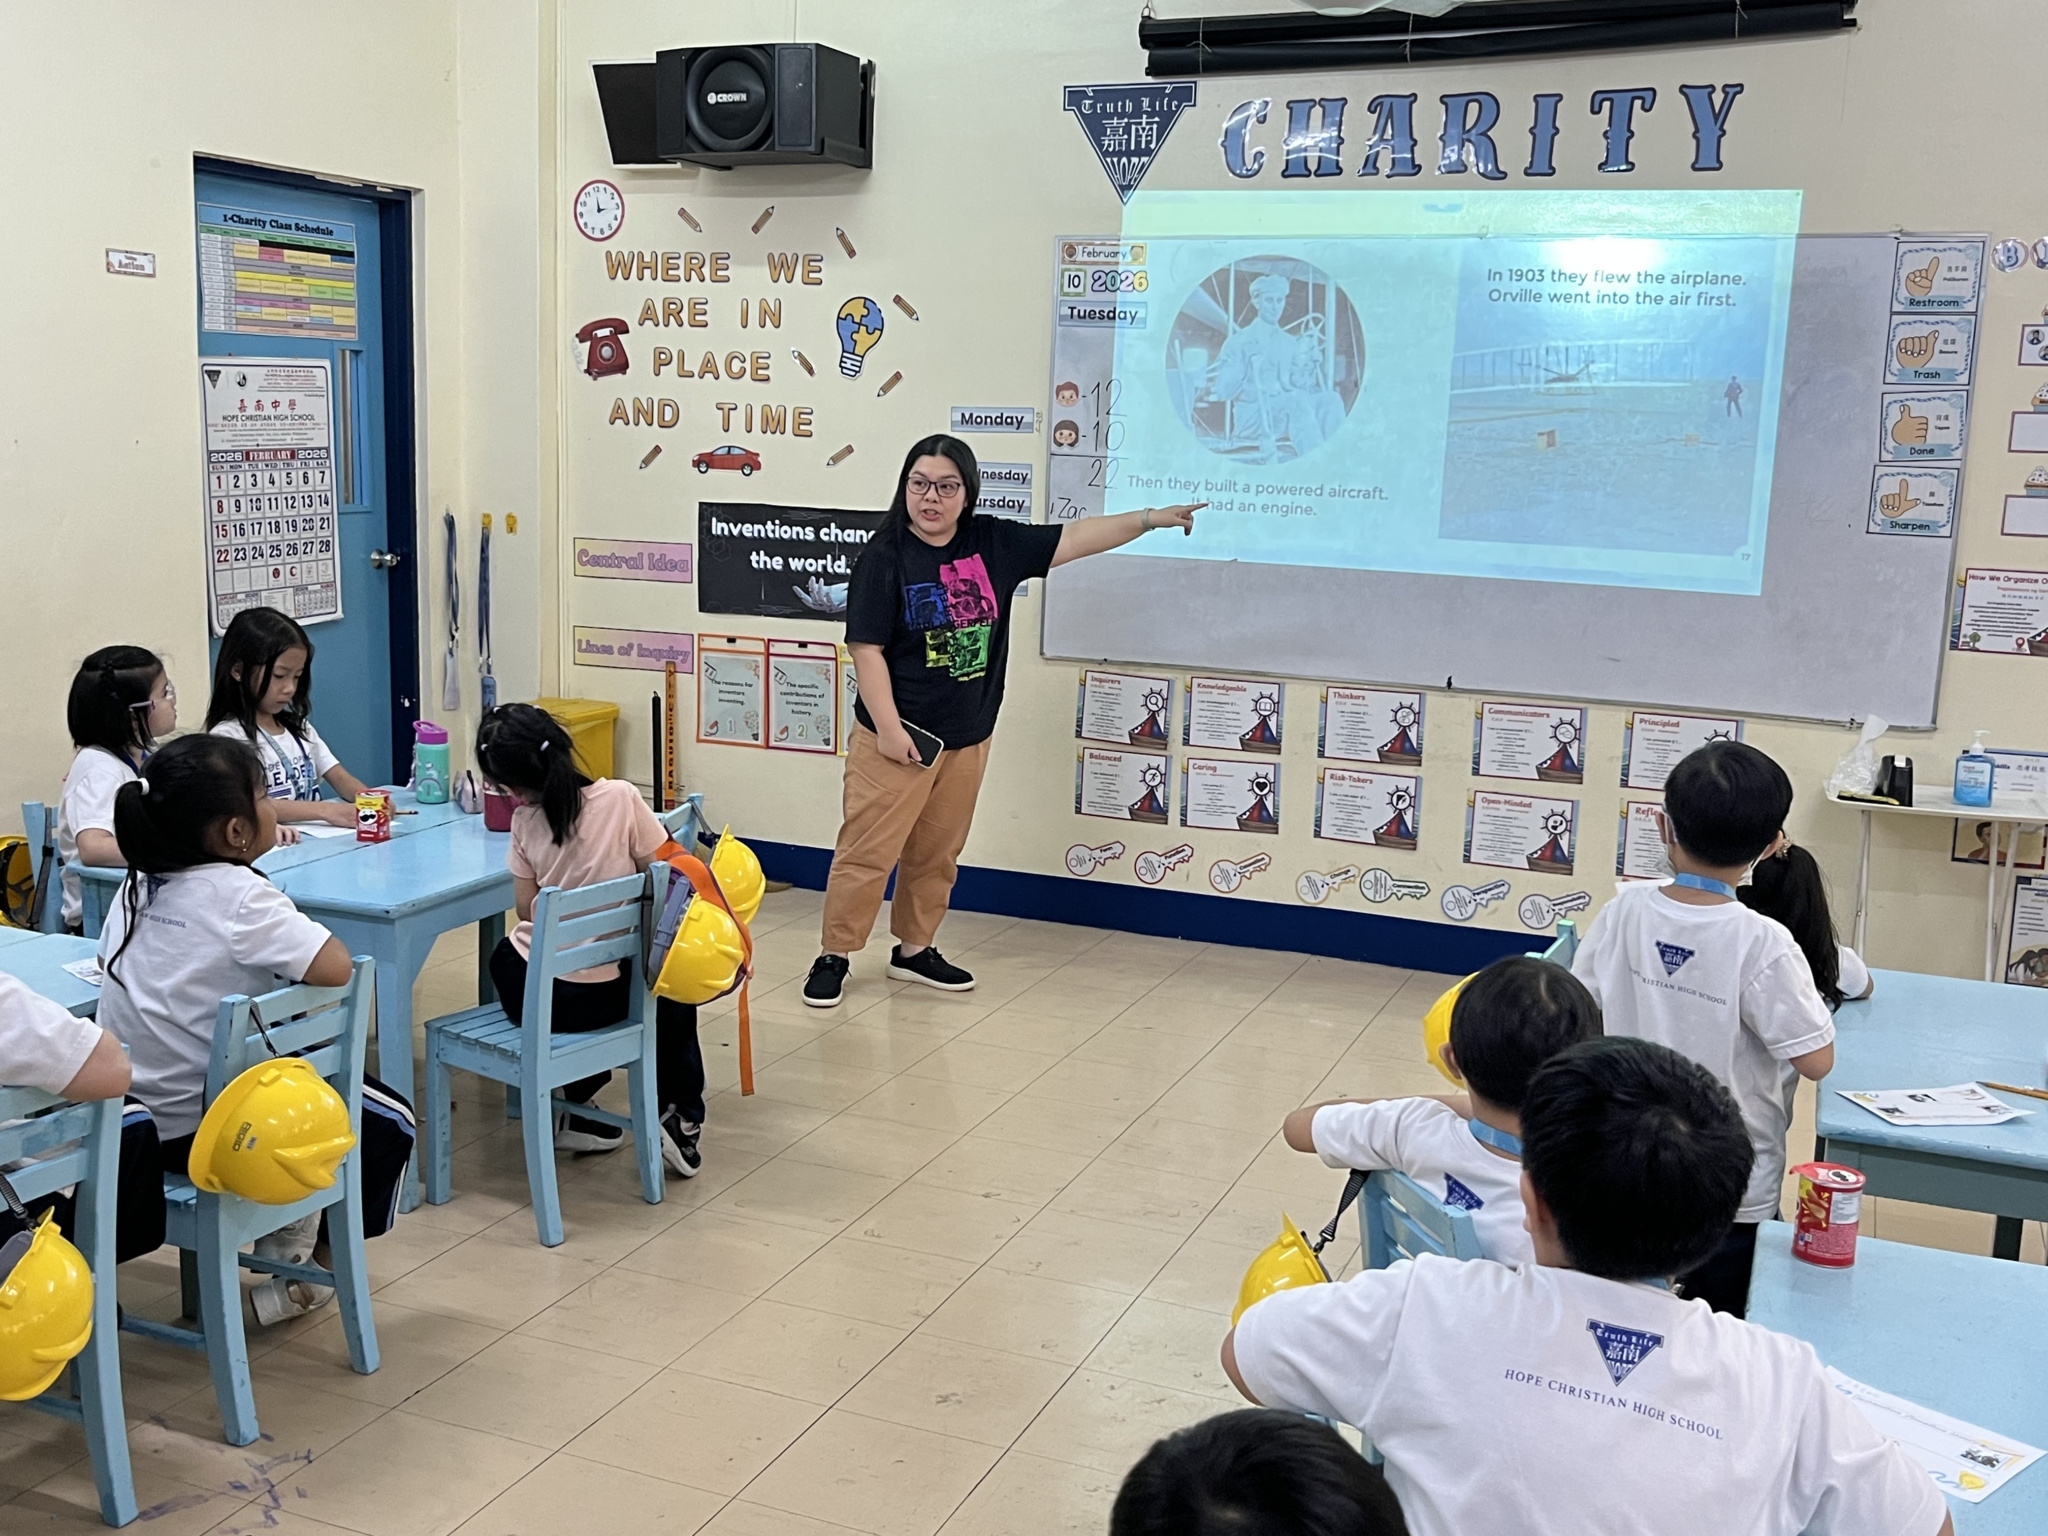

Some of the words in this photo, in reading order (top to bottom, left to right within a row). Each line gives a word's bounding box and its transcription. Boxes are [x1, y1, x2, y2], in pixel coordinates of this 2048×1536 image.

[717, 92, 747, 103] CROWN
[1081, 99, 1133, 114] Truth
[1141, 97, 1179, 112] Life
[1101, 114, 1160, 152] 嘉南
[1219, 82, 1744, 180] CHARITY
[1105, 156, 1150, 185] HOPE
[269, 219, 293, 231] Class
[294, 223, 334, 236] Schedule
[1081, 247, 1127, 260] February
[605, 250, 730, 283] WHERE
[767, 252, 823, 285] WE
[1067, 274, 1081, 288] 10
[1091, 270, 1148, 292] 2026
[1487, 268, 1503, 282] In
[1508, 269, 1545, 283] 1903
[1550, 269, 1588, 287] they
[1594, 270, 1631, 284] flew
[1637, 271, 1665, 285] the
[1670, 271, 1747, 288] airplane.
[1488, 289, 1543, 303] Orville
[1549, 292, 1591, 304] went
[1596, 290, 1629, 305] into
[1636, 292, 1664, 305] the
[1669, 292, 1691, 306] air
[1696, 291, 1736, 307] first.
[1909, 299, 1959, 307] Restroom
[638, 297, 708, 327] ARE
[740, 298, 781, 328] IN
[1068, 306, 1138, 325] Tuesday
[653, 346, 771, 382] PLACE
[1913, 371, 1941, 379] Trash
[1091, 379, 1128, 417] 12
[222, 414, 239, 422] HOPE
[240, 414, 272, 422] CHRISTIAN
[290, 413, 315, 421] SCHOOL
[608, 397, 680, 428] AND
[715, 402, 814, 437] TIME
[961, 412, 1024, 430] Monday
[1093, 420, 1125, 452] 10
[210, 452, 242, 462] 2026
[250, 450, 292, 461] FEBRUARY
[298, 450, 328, 459] 2026
[1910, 447, 1935, 455] Done
[216, 476, 221, 489] 1
[233, 475, 240, 488] 2
[251, 474, 258, 487] 3
[269, 473, 275, 487] 4
[286, 472, 292, 485] 5
[302, 471, 309, 484] 6
[319, 471, 325, 484] 7
[979, 468, 1028, 485] nesday
[1088, 458, 1119, 489] 22
[1127, 475, 1163, 489] Then
[1168, 477, 1200, 494] they
[1205, 478, 1238, 493] built
[1243, 484, 1250, 493] a
[1255, 483, 1324, 498] powered
[1328, 485, 1389, 501] aircraft.
[217, 500, 223, 514] 8
[235, 499, 241, 512] 9
[249, 498, 262, 511] 10
[267, 497, 279, 510] 11
[284, 496, 297, 509] 12
[301, 494, 313, 508] 13
[318, 493, 329, 507] 14
[976, 496, 1025, 513] ursday
[1206, 498, 1233, 512] had
[1238, 502, 1256, 513] an
[1261, 502, 1317, 518] engine.
[215, 524, 228, 538] 15
[232, 523, 245, 537] 16
[250, 522, 262, 535] 17
[268, 520, 280, 534] 18
[285, 519, 297, 533] 19
[302, 518, 314, 531] 20
[319, 517, 330, 530] 21
[711, 517, 815, 542] Inventions
[1889, 521, 1930, 531] Sharpen
[217, 549, 229, 563] 22
[234, 548, 247, 561] 23
[252, 546, 264, 560] 24
[269, 545, 282, 558] 25
[286, 543, 298, 556] 26
[303, 541, 314, 555] 27
[319, 540, 330, 553] 28
[1741, 553, 1751, 561] 17
[577, 549, 644, 570] Central
[648, 552, 690, 573] Idea
[750, 550, 783, 571] the
[788, 554, 852, 575] world.
[2003, 576, 2039, 584] Organize
[577, 639, 614, 656] Lines
[617, 643, 635, 656] of
[637, 644, 691, 665] Inquiry
[1091, 676, 1121, 685] Inquirers
[1197, 683, 1247, 692] Knowledgeable
[1333, 692, 1366, 700] Thinkers
[1488, 708, 1550, 718] Communicators
[728, 719, 734, 732] 1
[797, 724, 805, 737] 2
[1639, 718, 1680, 728] Principled
[1089, 752, 1122, 762] Balanced
[1192, 763, 1217, 773] Caring
[1330, 774, 1373, 784] Risk-Takers
[1481, 797, 1532, 808] Open-Minded
[1642, 977, 1675, 990] RISTIAN
[1504, 1368, 1543, 1387] HOPE
[1548, 1379, 1627, 1409] CHRISTIAN
[1632, 1401, 1665, 1422] HIGH
[1669, 1414, 1723, 1441] SCHOOL
